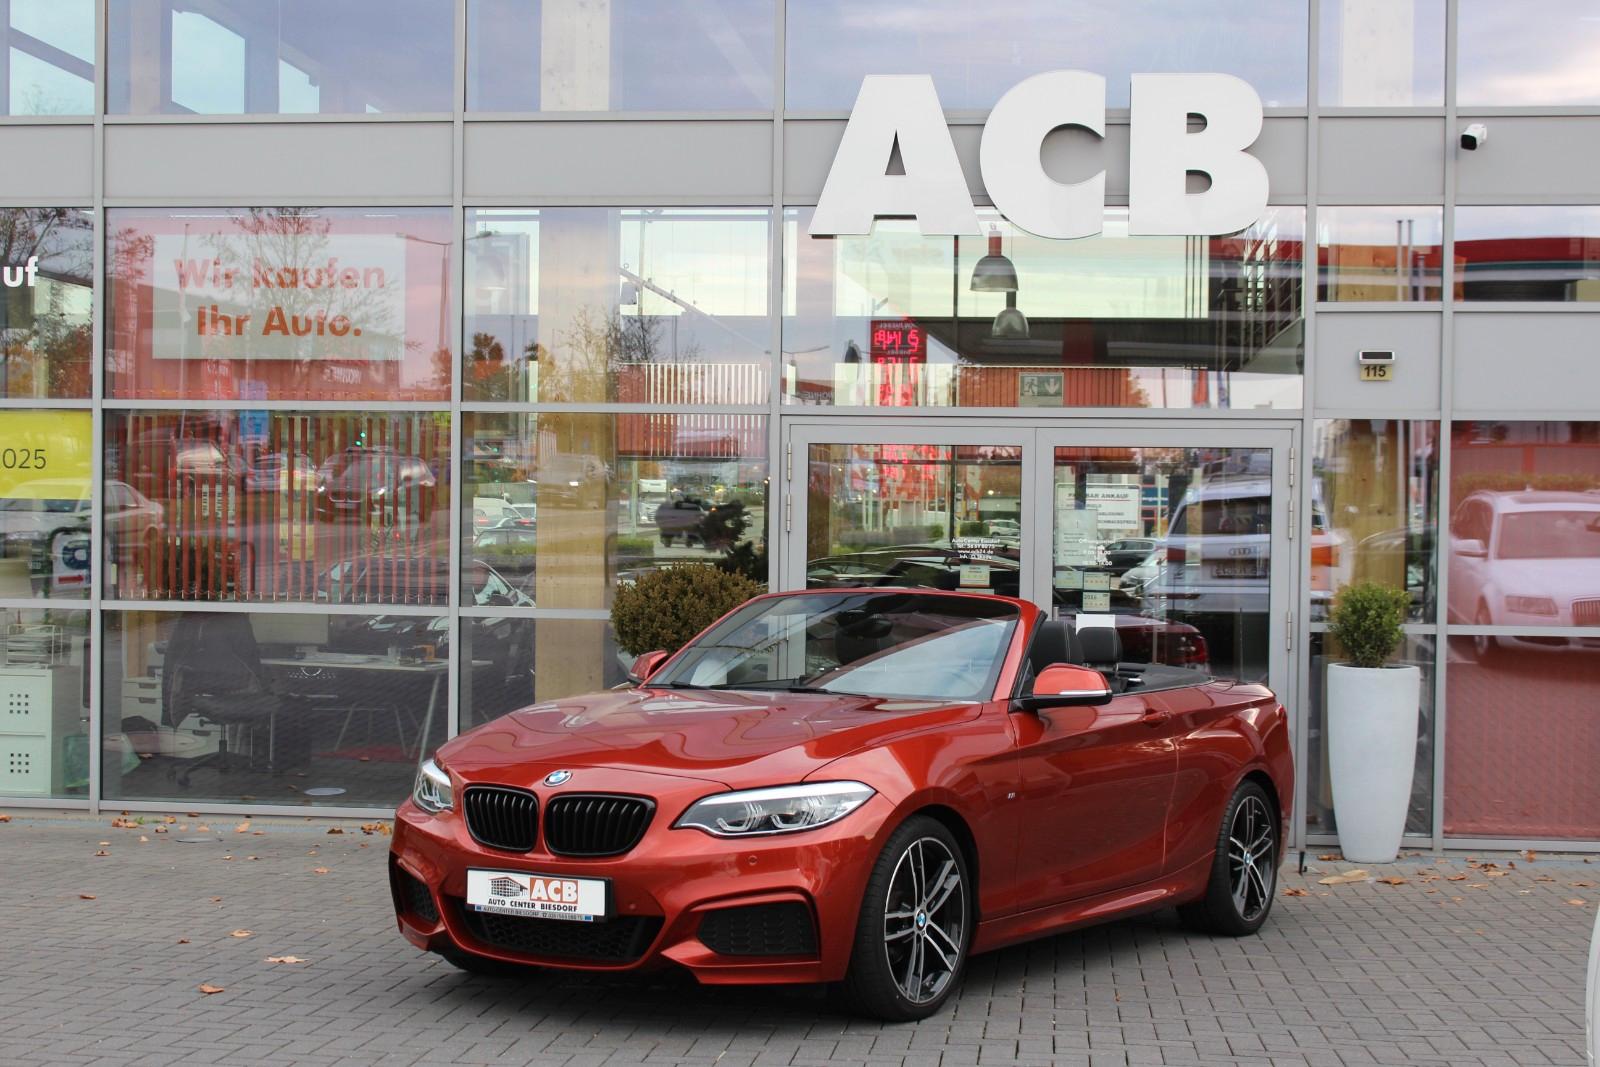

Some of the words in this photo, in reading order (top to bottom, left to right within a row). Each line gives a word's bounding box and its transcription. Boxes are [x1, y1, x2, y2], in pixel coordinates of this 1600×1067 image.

[807, 70, 1270, 240] ACB
[174, 257, 240, 288] Wir
[253, 257, 385, 288] kaufen
[198, 304, 250, 336] Ihr
[262, 307, 362, 336] Auto.
[1364, 366, 1386, 377] 115
[531, 880, 578, 902] ACB
[488, 898, 506, 906] AUTO
[510, 900, 536, 909] CENTER
[540, 902, 578, 912] BIESDORF
